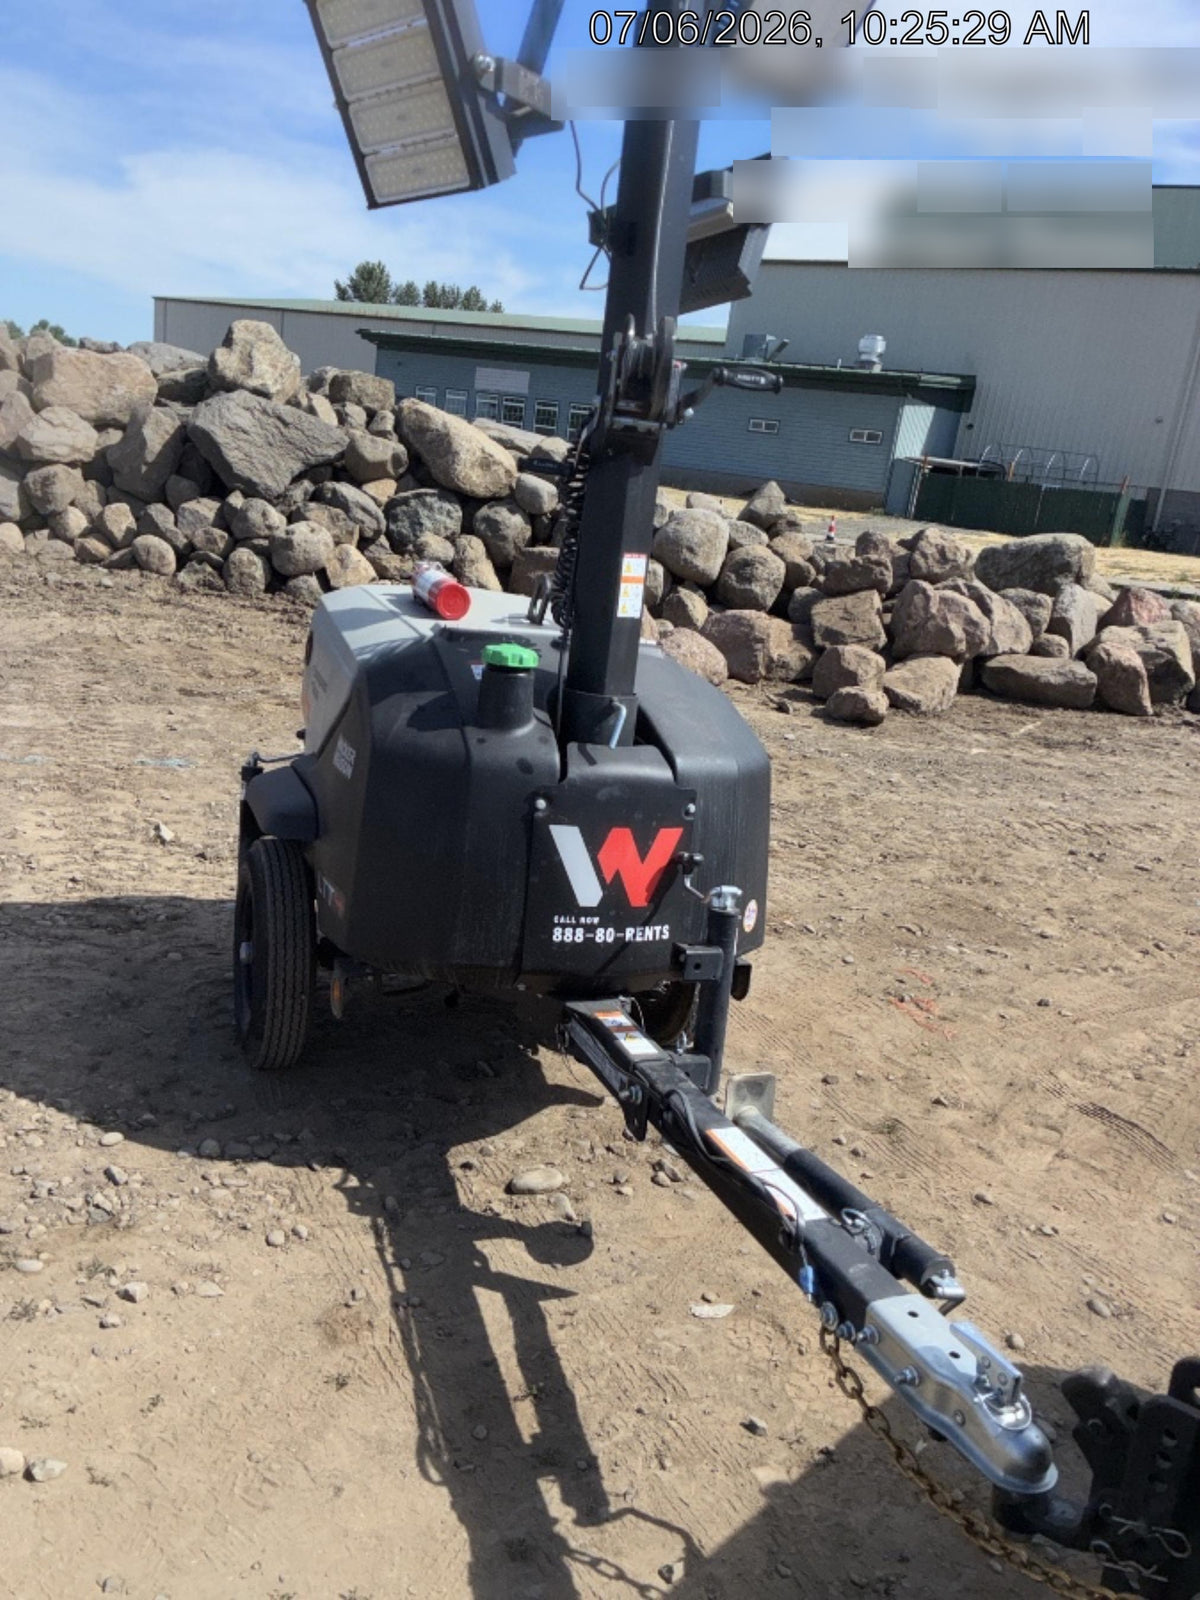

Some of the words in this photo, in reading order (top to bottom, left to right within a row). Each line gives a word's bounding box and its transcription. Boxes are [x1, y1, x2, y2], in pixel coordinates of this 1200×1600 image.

[553, 915, 577, 924] CALL
[580, 916, 600, 925] NOW
[553, 924, 670, 943] 888-80-RENTS
